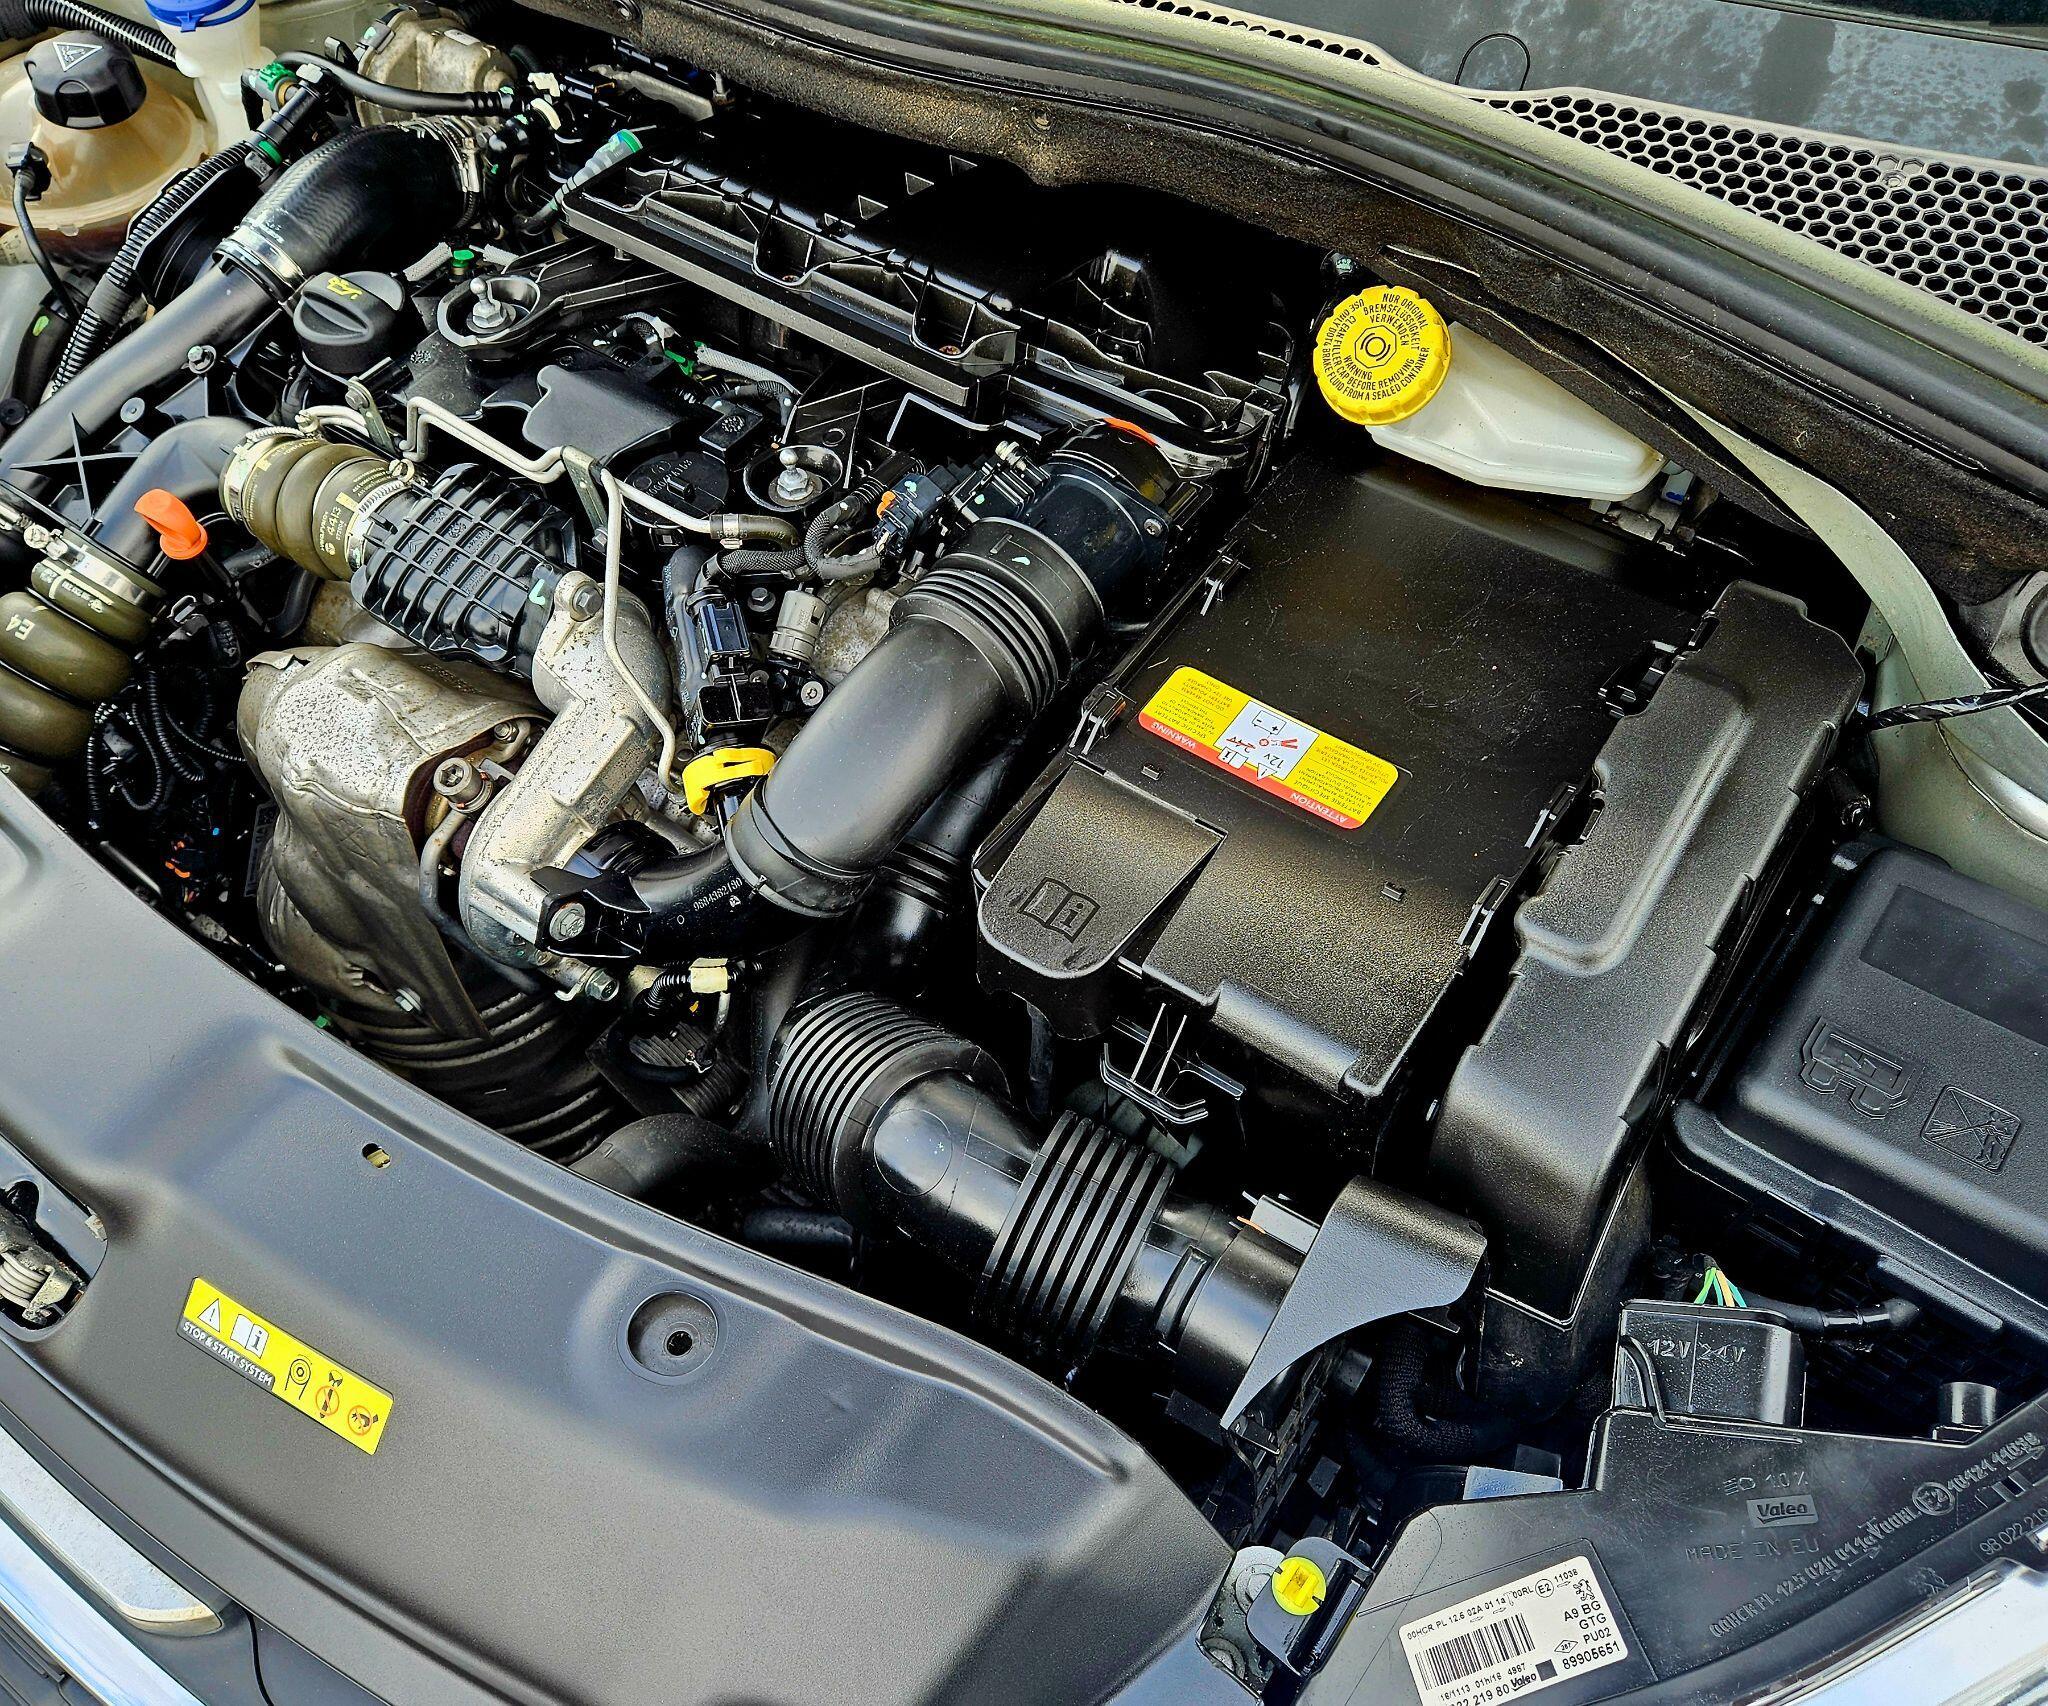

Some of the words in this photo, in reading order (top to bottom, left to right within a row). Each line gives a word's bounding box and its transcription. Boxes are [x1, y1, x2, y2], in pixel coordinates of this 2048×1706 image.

[1350, 299, 1364, 312] USE
[1382, 293, 1400, 303] NUR
[1401, 298, 1428, 330] ORIGINAL
[1339, 316, 1357, 339] CLEAN
[1364, 304, 1420, 350] BREMSFLÜSSIGKEIT
[1370, 314, 1409, 346] VERWENDEN
[1322, 348, 1331, 373] BRAKE
[1332, 340, 1342, 367] FILLER
[1336, 366, 1350, 380] CAP
[1344, 355, 1372, 380] WARNING
[1378, 358, 1415, 389] REMOVING
[1400, 347, 1430, 387] CONTAINER
[1327, 372, 1344, 391] FLUID
[1343, 387, 1364, 400] FROM
[1347, 376, 1376, 391] BEFORE
[1372, 386, 1401, 401] SEALED
[6, 614, 36, 640] E4
[1151, 722, 1197, 749] WARNING
[1290, 792, 1348, 823] ATTENTION
[183, 1321, 206, 1340] STOP
[212, 1342, 240, 1364] START
[239, 1359, 274, 1386] SYSTEM
[1647, 1339, 1691, 1359] 12V
[1757, 1502, 1809, 1517] Valeo
[1685, 1542, 1744, 1562] MADE
[1752, 1540, 1781, 1557] IN
[1790, 1538, 1820, 1555] EU
[1980, 1538, 2001, 1555] 98
[1998, 1522, 2027, 1545] 022
[1407, 1625, 1435, 1641] 00HCR
[1436, 1620, 1448, 1632] PL
[1467, 1605, 1484, 1618] 02A
[1484, 1600, 1494, 1612] 01
[1538, 1583, 1552, 1594] E2
[1554, 1568, 1578, 1583] 11038
[1563, 1608, 1580, 1622] A9
[1583, 1601, 1602, 1616] BG
[1579, 1614, 1608, 1630] GTG
[1583, 1628, 1612, 1645] PU02
[1562, 1642, 1620, 1670] 89905651
[1473, 1690, 1493, 1706] 219
[1496, 1684, 1510, 1697] 80
[1510, 1673, 1537, 1691] Valeo
